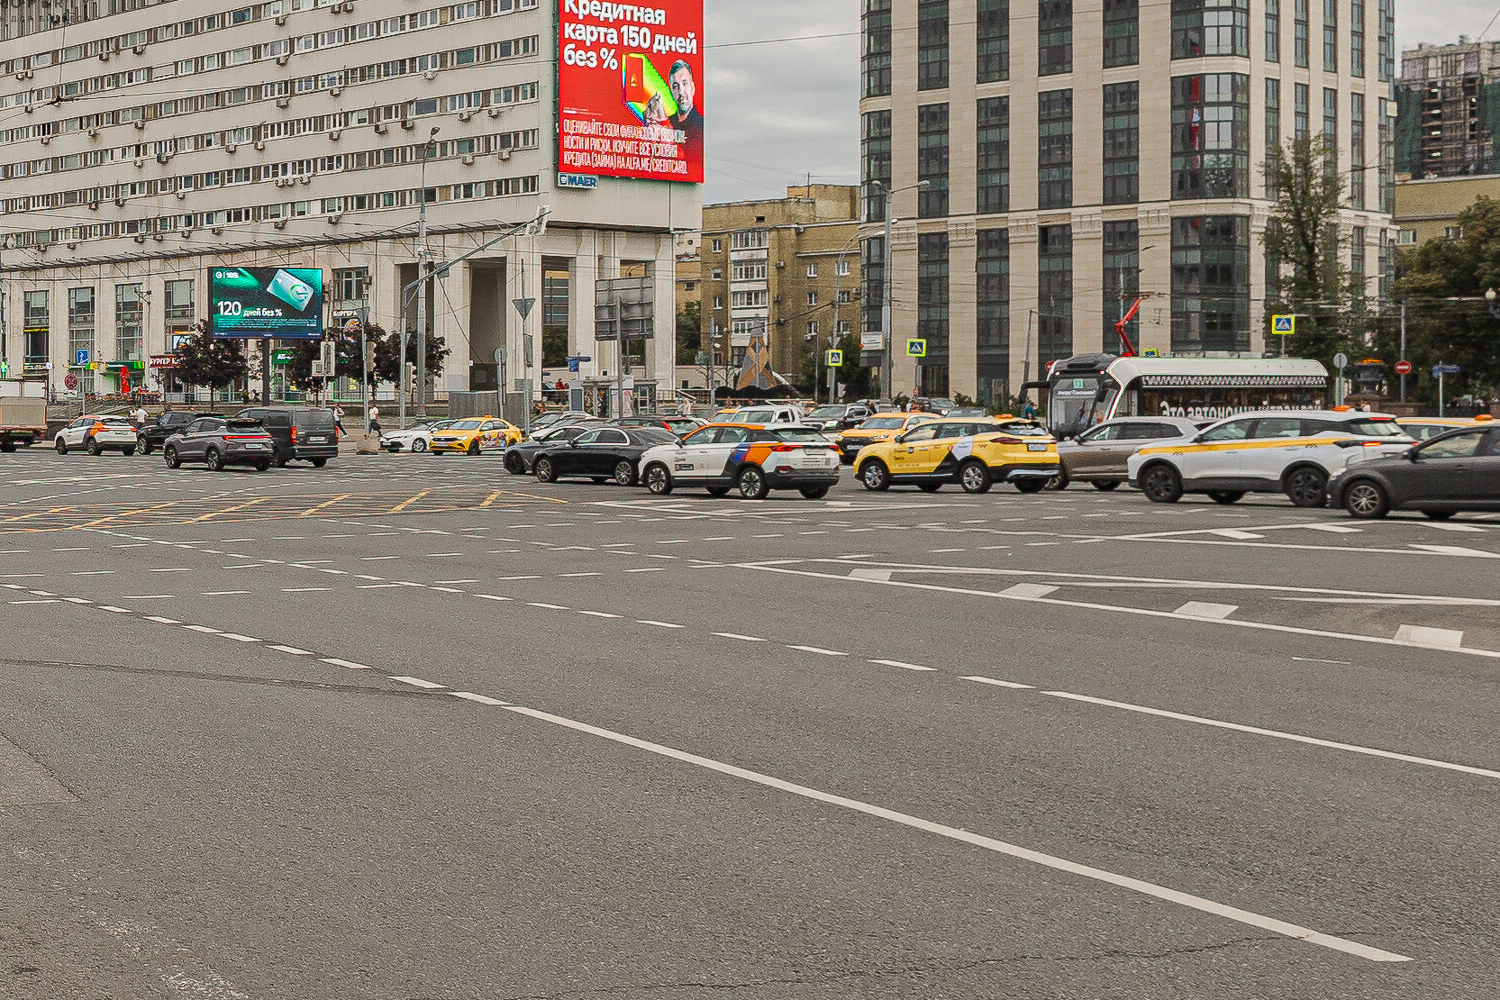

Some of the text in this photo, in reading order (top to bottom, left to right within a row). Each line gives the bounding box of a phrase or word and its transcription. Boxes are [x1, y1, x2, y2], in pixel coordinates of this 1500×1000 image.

[564, 22, 697, 55] карта 150 дней
[563, 43, 619, 70] без %
[568, 175, 598, 187] MAER
[217, 301, 283, 317] 120 дней без %
[1160, 401, 1185, 417] Это
